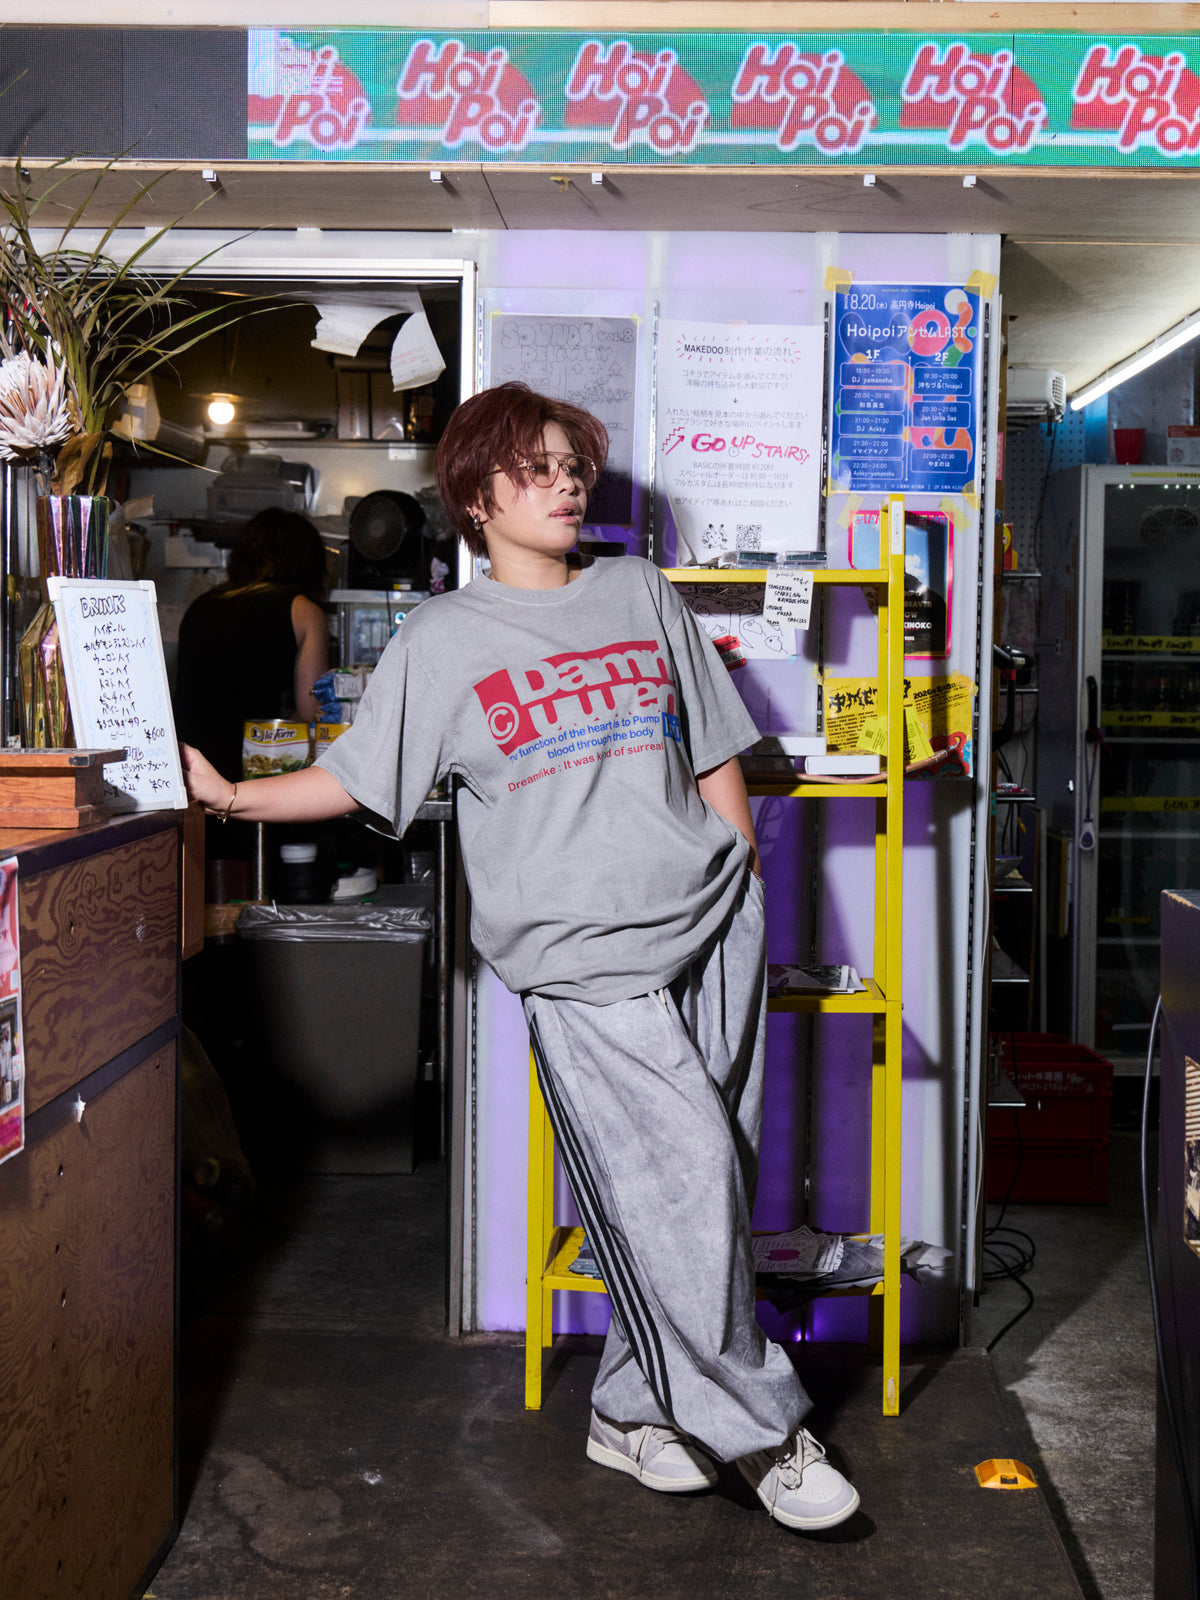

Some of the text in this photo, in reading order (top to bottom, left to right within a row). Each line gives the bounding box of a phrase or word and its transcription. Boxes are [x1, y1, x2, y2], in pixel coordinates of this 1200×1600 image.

[398, 39, 507, 98] Hoi
[564, 39, 677, 100] Hoi
[730, 41, 844, 100] Hoi
[902, 41, 1014, 100] Hoi
[1072, 42, 1185, 101] Hoi
[442, 95, 540, 152] Poi
[611, 97, 709, 152] Poi
[777, 95, 877, 156] Poi
[946, 95, 1048, 156] Poi
[866, 350, 881, 358] 1F
[935, 352, 949, 361] 2F
[691, 433, 726, 452] GO
[731, 435, 756, 450] UP
[518, 737, 557, 758] function
[558, 730, 568, 743] of
[569, 727, 586, 739] the
[587, 721, 613, 734] heart
[621, 717, 631, 727] to
[632, 714, 660, 726] Pump
[547, 743, 575, 759] blood
[577, 734, 612, 751] through
[612, 730, 628, 743] the
[629, 726, 655, 740] body
[563, 760, 572, 770] It
[573, 754, 596, 767] was
[613, 745, 625, 757] of
[627, 741, 665, 756] surreal
